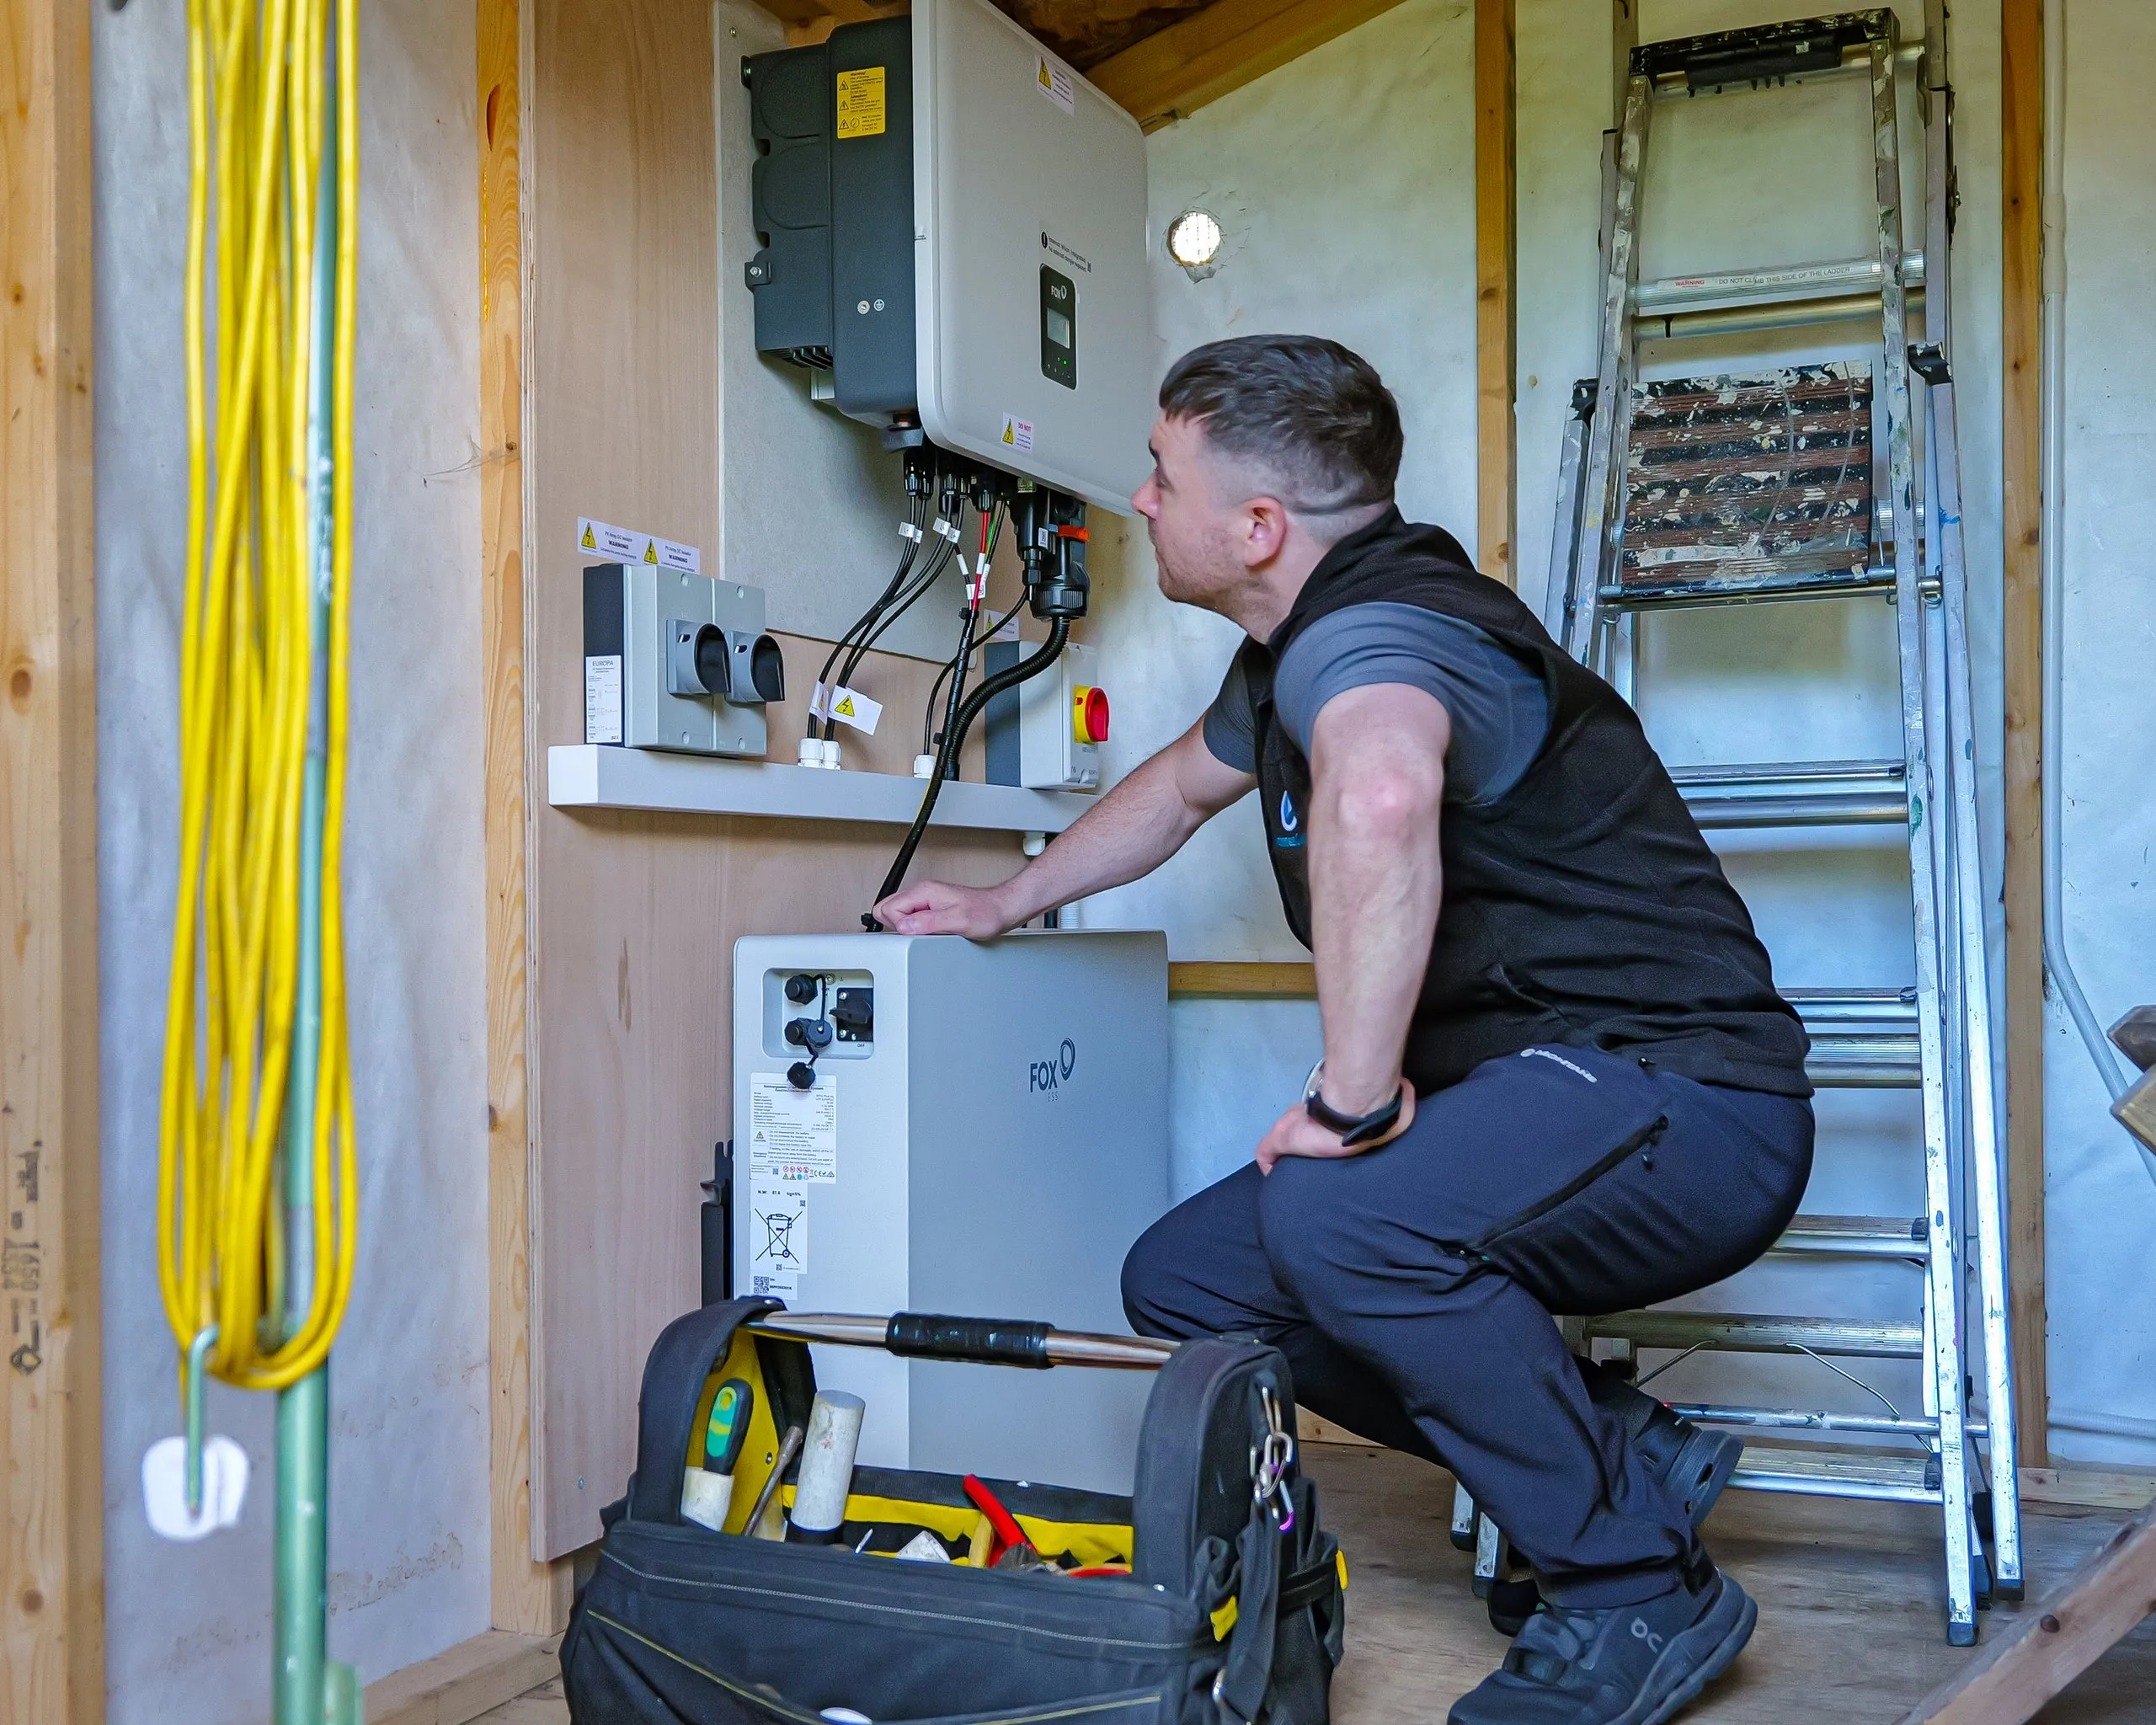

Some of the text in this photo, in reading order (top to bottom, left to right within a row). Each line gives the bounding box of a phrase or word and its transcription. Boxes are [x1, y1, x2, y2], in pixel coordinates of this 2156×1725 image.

[1744, 275, 1764, 285] CLIMB
[1823, 266, 1851, 275] LADDER
[608, 540, 629, 550] WARNING
[669, 554, 688, 563] WARNING
[1030, 1060, 1058, 1093] FOX
[1048, 1091, 1059, 1103] ESS
